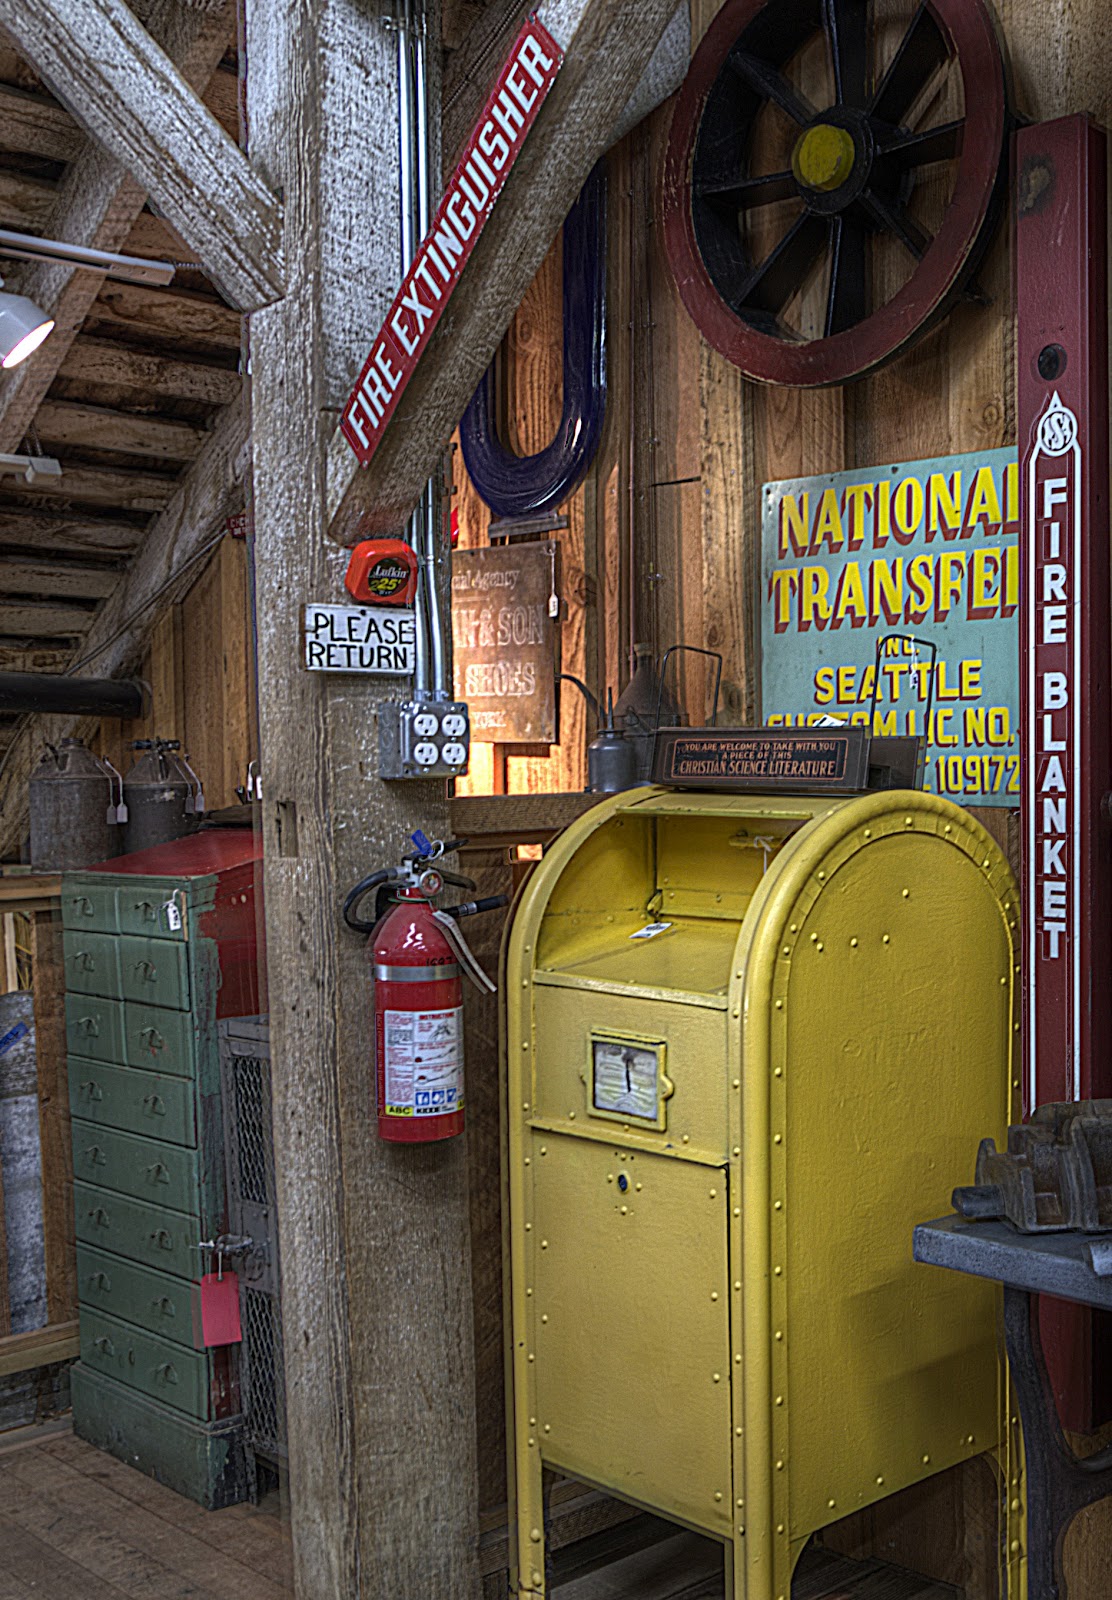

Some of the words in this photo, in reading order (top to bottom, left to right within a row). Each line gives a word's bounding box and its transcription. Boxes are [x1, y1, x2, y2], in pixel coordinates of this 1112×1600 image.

[347, 341, 403, 449] FIRE
[391, 34, 553, 357] EXTINGUISHER
[374, 565, 407, 579] Lufkin
[1043, 477, 1067, 644] FIRE
[474, 568, 520, 591] Agency
[314, 612, 414, 645] PLEASE
[480, 607, 495, 647] &
[497, 604, 545, 647] SON
[308, 641, 408, 669] RETURN
[465, 661, 535, 697] SHOES
[814, 659, 983, 705] SEATTLE
[963, 706, 1015, 747] NO.
[685, 742, 701, 752] YOU
[701, 742, 718, 752] ARE
[720, 742, 758, 751] WELCOME
[760, 742, 770, 751] TO
[773, 742, 794, 751] TAKE
[795, 742, 817, 751] WITH
[819, 742, 836, 751] YOU
[722, 751, 728, 760] A
[730, 751, 755, 760] PIECE
[757, 751, 769, 760] OF
[772, 751, 792, 760] THIS
[680, 760, 727, 775] CHRISTIAN
[728, 760, 768, 775] SCIENCE
[768, 760, 836, 776] LITERATURE
[935, 754, 1019, 795] 109172
[1041, 672, 1068, 958] BLANKET
[388, 1106, 410, 1115] ABC
